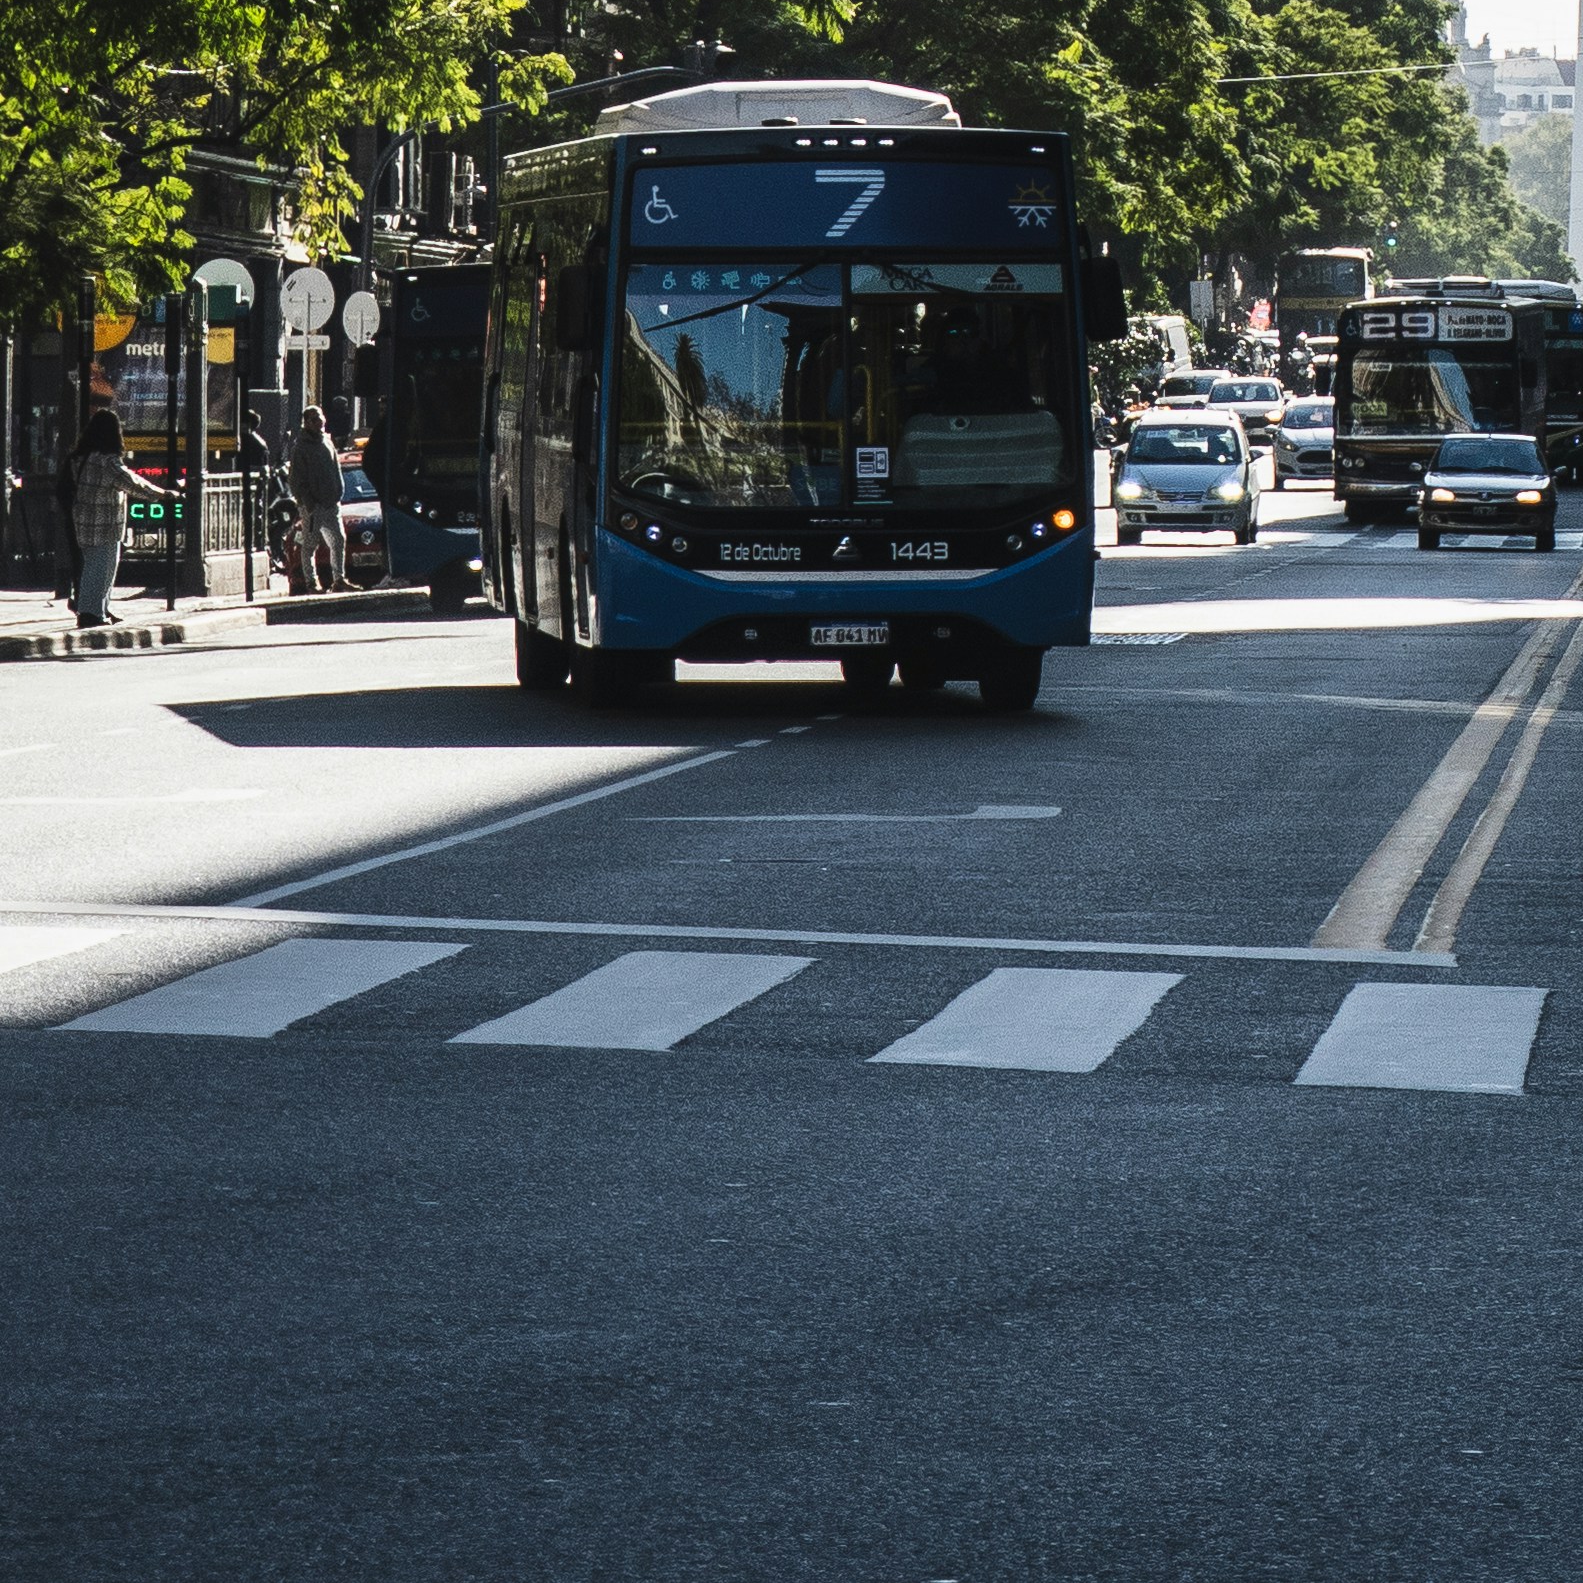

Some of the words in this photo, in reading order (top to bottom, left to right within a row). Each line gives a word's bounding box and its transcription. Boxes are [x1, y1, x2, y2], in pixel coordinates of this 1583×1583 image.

[815, 169, 885, 237] 7
[1363, 312, 1436, 340] 29
[720, 543, 732, 561] 12
[734, 542, 750, 561] de
[752, 542, 801, 561] Octubre
[890, 541, 949, 561] 1443
